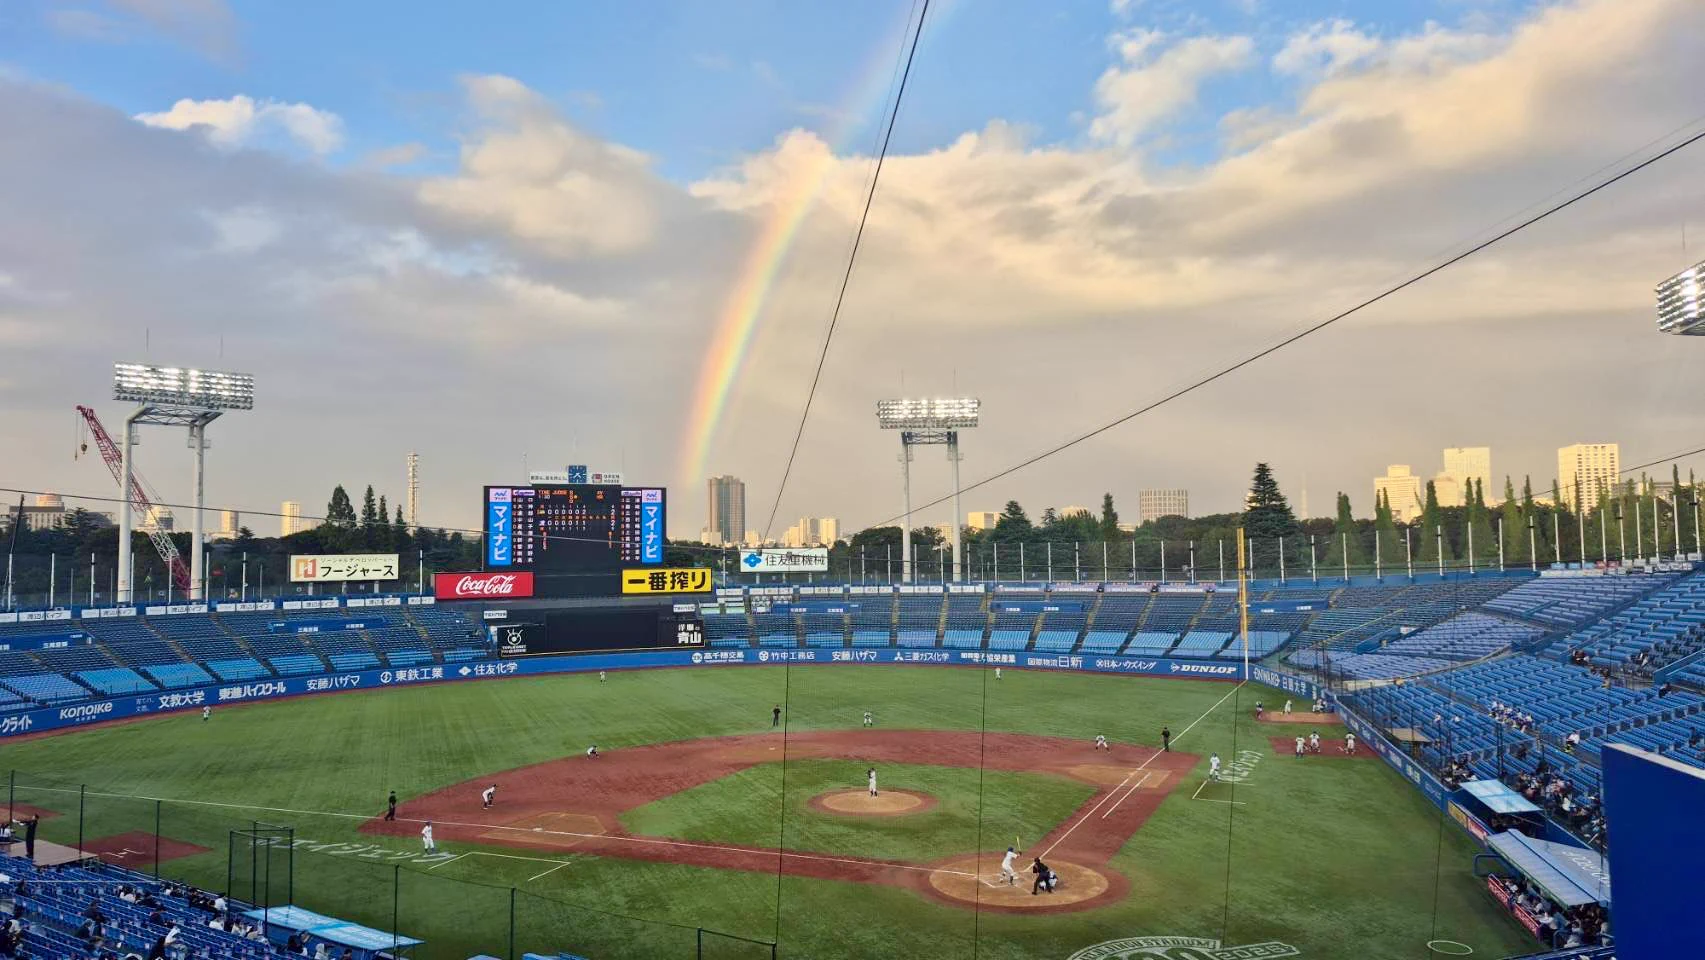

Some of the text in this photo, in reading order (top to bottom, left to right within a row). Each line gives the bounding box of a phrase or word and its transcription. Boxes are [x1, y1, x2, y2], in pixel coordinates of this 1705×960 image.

[493, 505, 508, 561] マイナビ
[645, 505, 658, 559] マイナビ
[320, 564, 394, 577] フージャース
[455, 575, 517, 595] Coca-Cola
[627, 571, 707, 591] 一番搾り
[677, 632, 702, 644] 青山
[771, 652, 815, 660] 竹中工務店
[904, 652, 950, 662] 三菱ガス化学
[395, 667, 443, 682] 東鉄工業
[474, 662, 518, 676] 住友化学
[1180, 664, 1237, 674] DUNLOP
[307, 675, 360, 690] 安藤ハザマ
[158, 690, 205, 709] 文教大学
